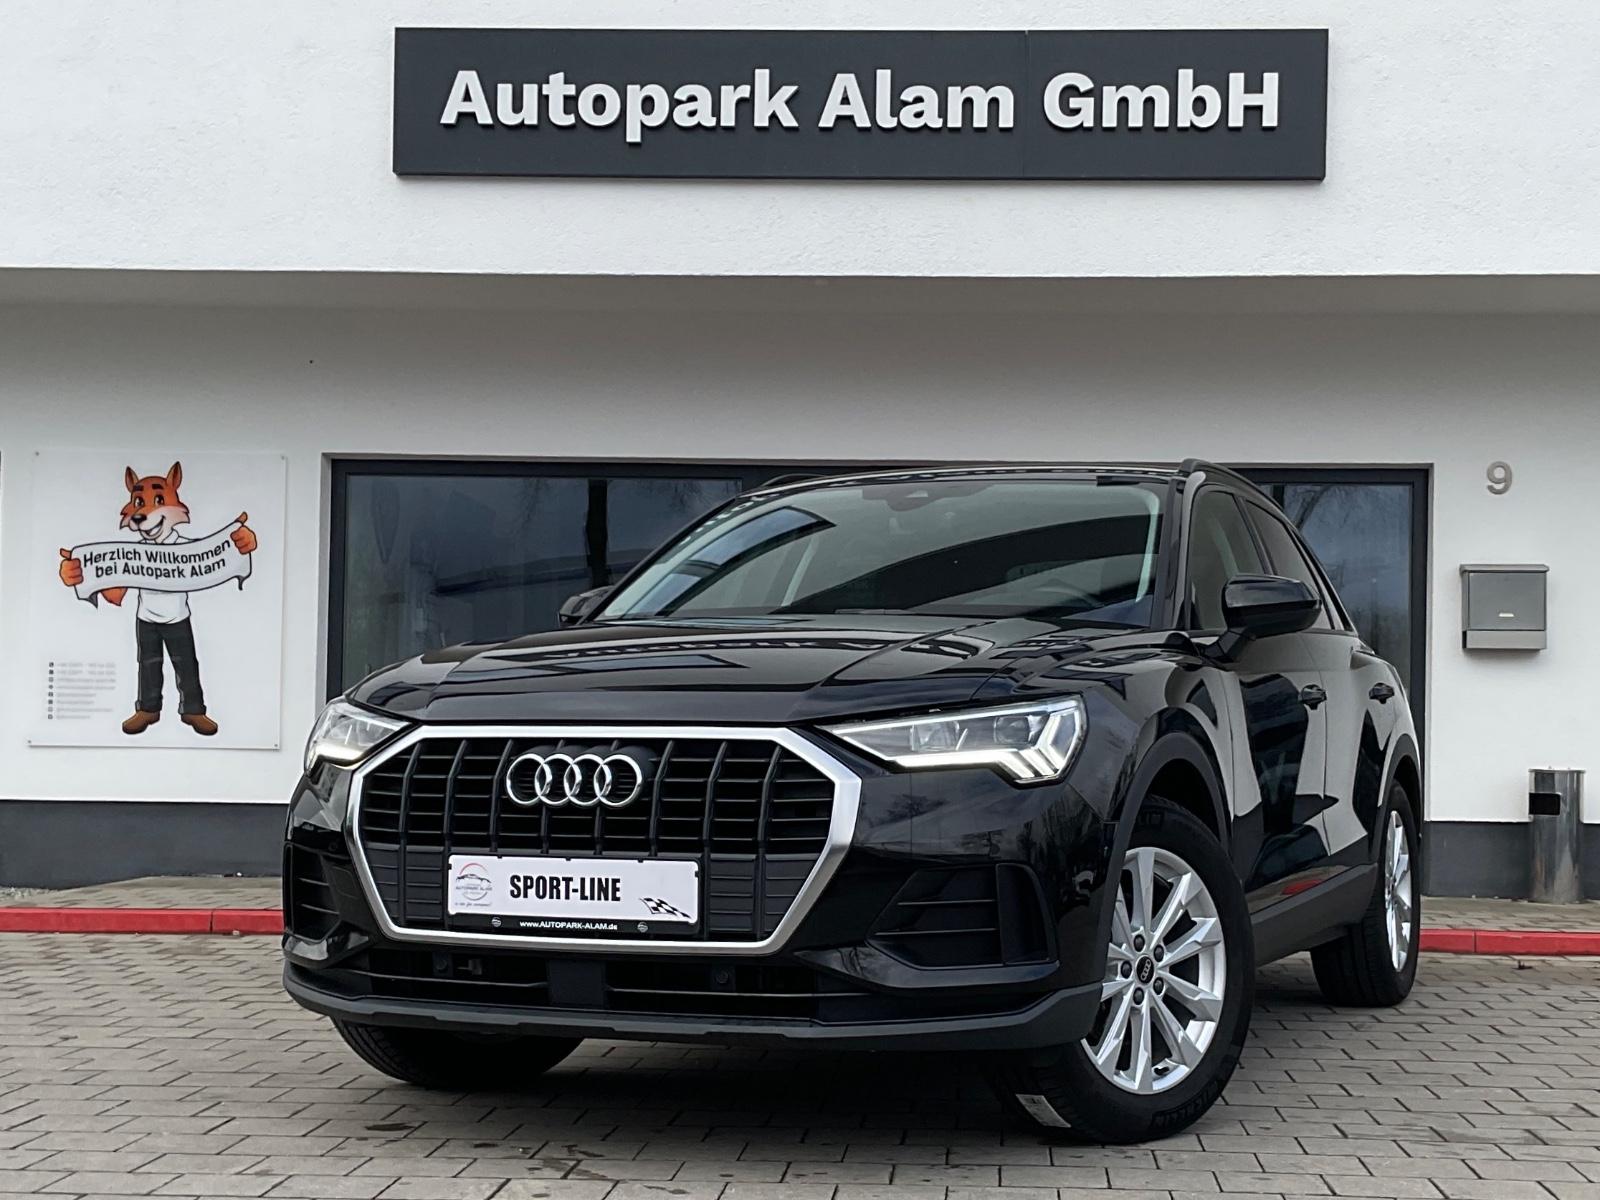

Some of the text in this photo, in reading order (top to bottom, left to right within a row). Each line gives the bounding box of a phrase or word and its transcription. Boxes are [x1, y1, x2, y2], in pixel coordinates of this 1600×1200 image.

[440, 69, 1279, 142] Autopark Alam GmbH
[1486, 461, 1513, 495] 9
[83, 539, 231, 568] Herzlich Willkommen
[95, 558, 226, 580] bei Autopark Alam
[509, 875, 621, 902] SPORT-LINE
[519, 920, 618, 931] www.AUTOPARK-ALAM.de
